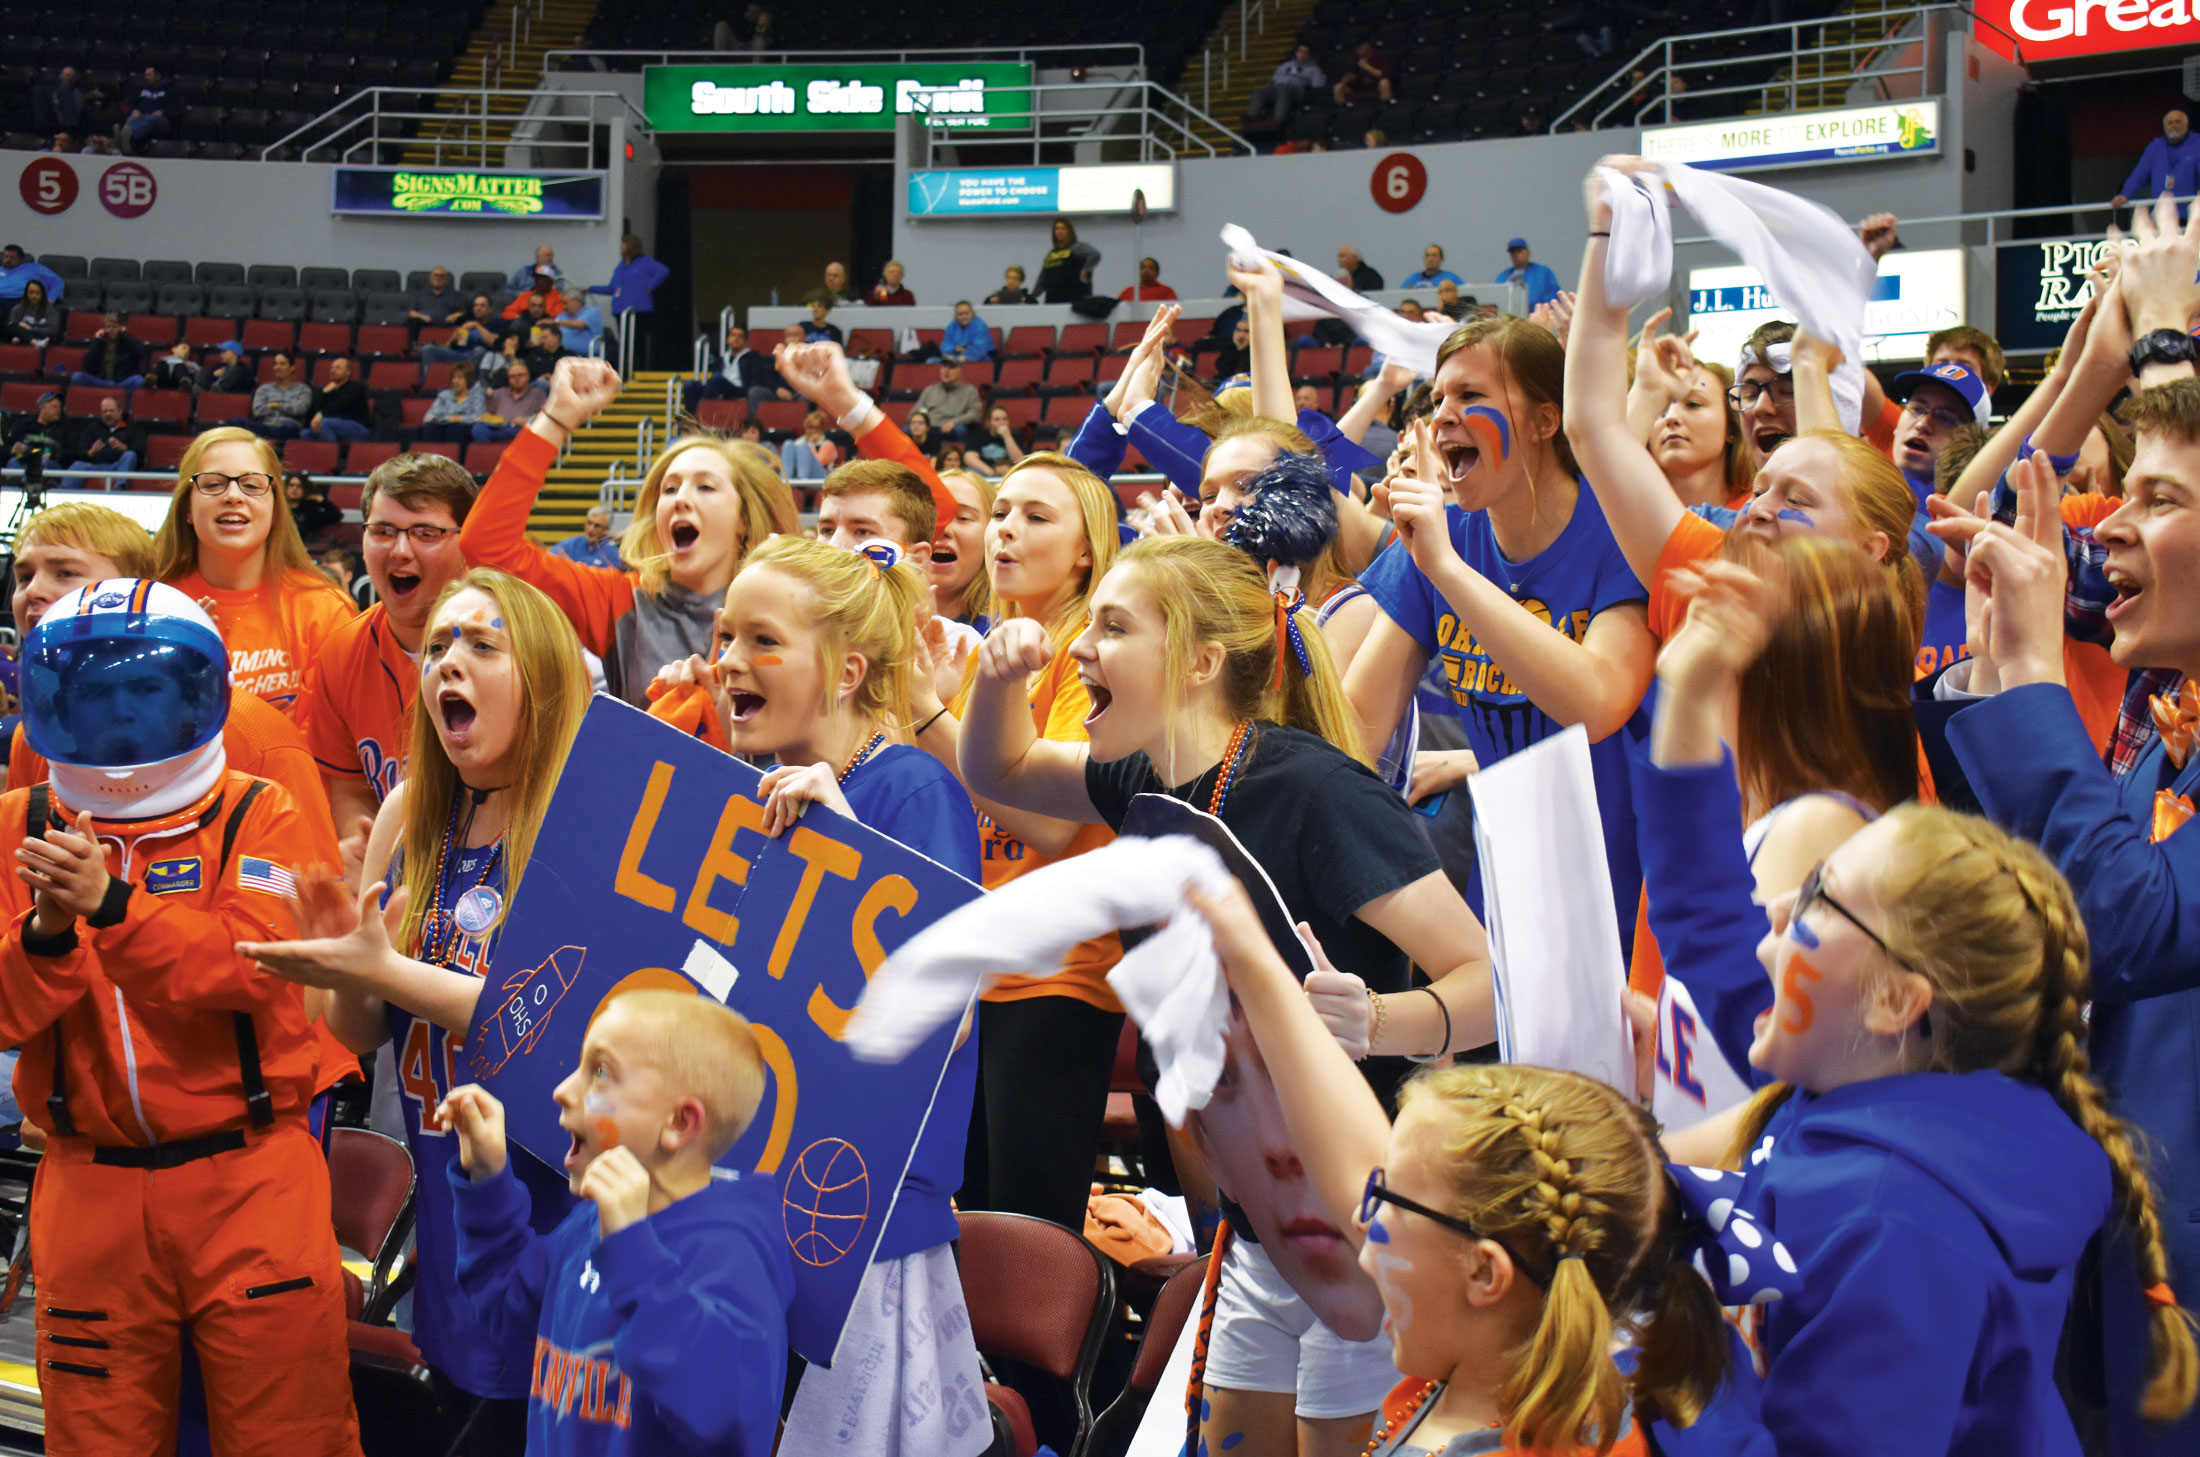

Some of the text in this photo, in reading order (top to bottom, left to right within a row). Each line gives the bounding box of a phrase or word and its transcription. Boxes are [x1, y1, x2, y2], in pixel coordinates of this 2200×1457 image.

[2009, 0, 2200, 42] Grea
[691, 80, 795, 114] South
[807, 80, 884, 113] Side
[1721, 128, 1772, 149] MORE
[1780, 126, 1798, 143] TO
[1805, 116, 1888, 141] EXPLORE
[40, 170, 61, 201] 5
[106, 174, 153, 206] 5B
[959, 178, 979, 187] YOU
[1007, 177, 1026, 186] THE
[959, 186, 1048, 197] POWER TO CHOOSE
[1387, 166, 1409, 199] 6
[1693, 285, 1776, 313] J.L. Hu
[152, 879, 195, 892] COMMANDER
[614, 760, 919, 1042] LETS
[509, 996, 532, 1037] OHS
